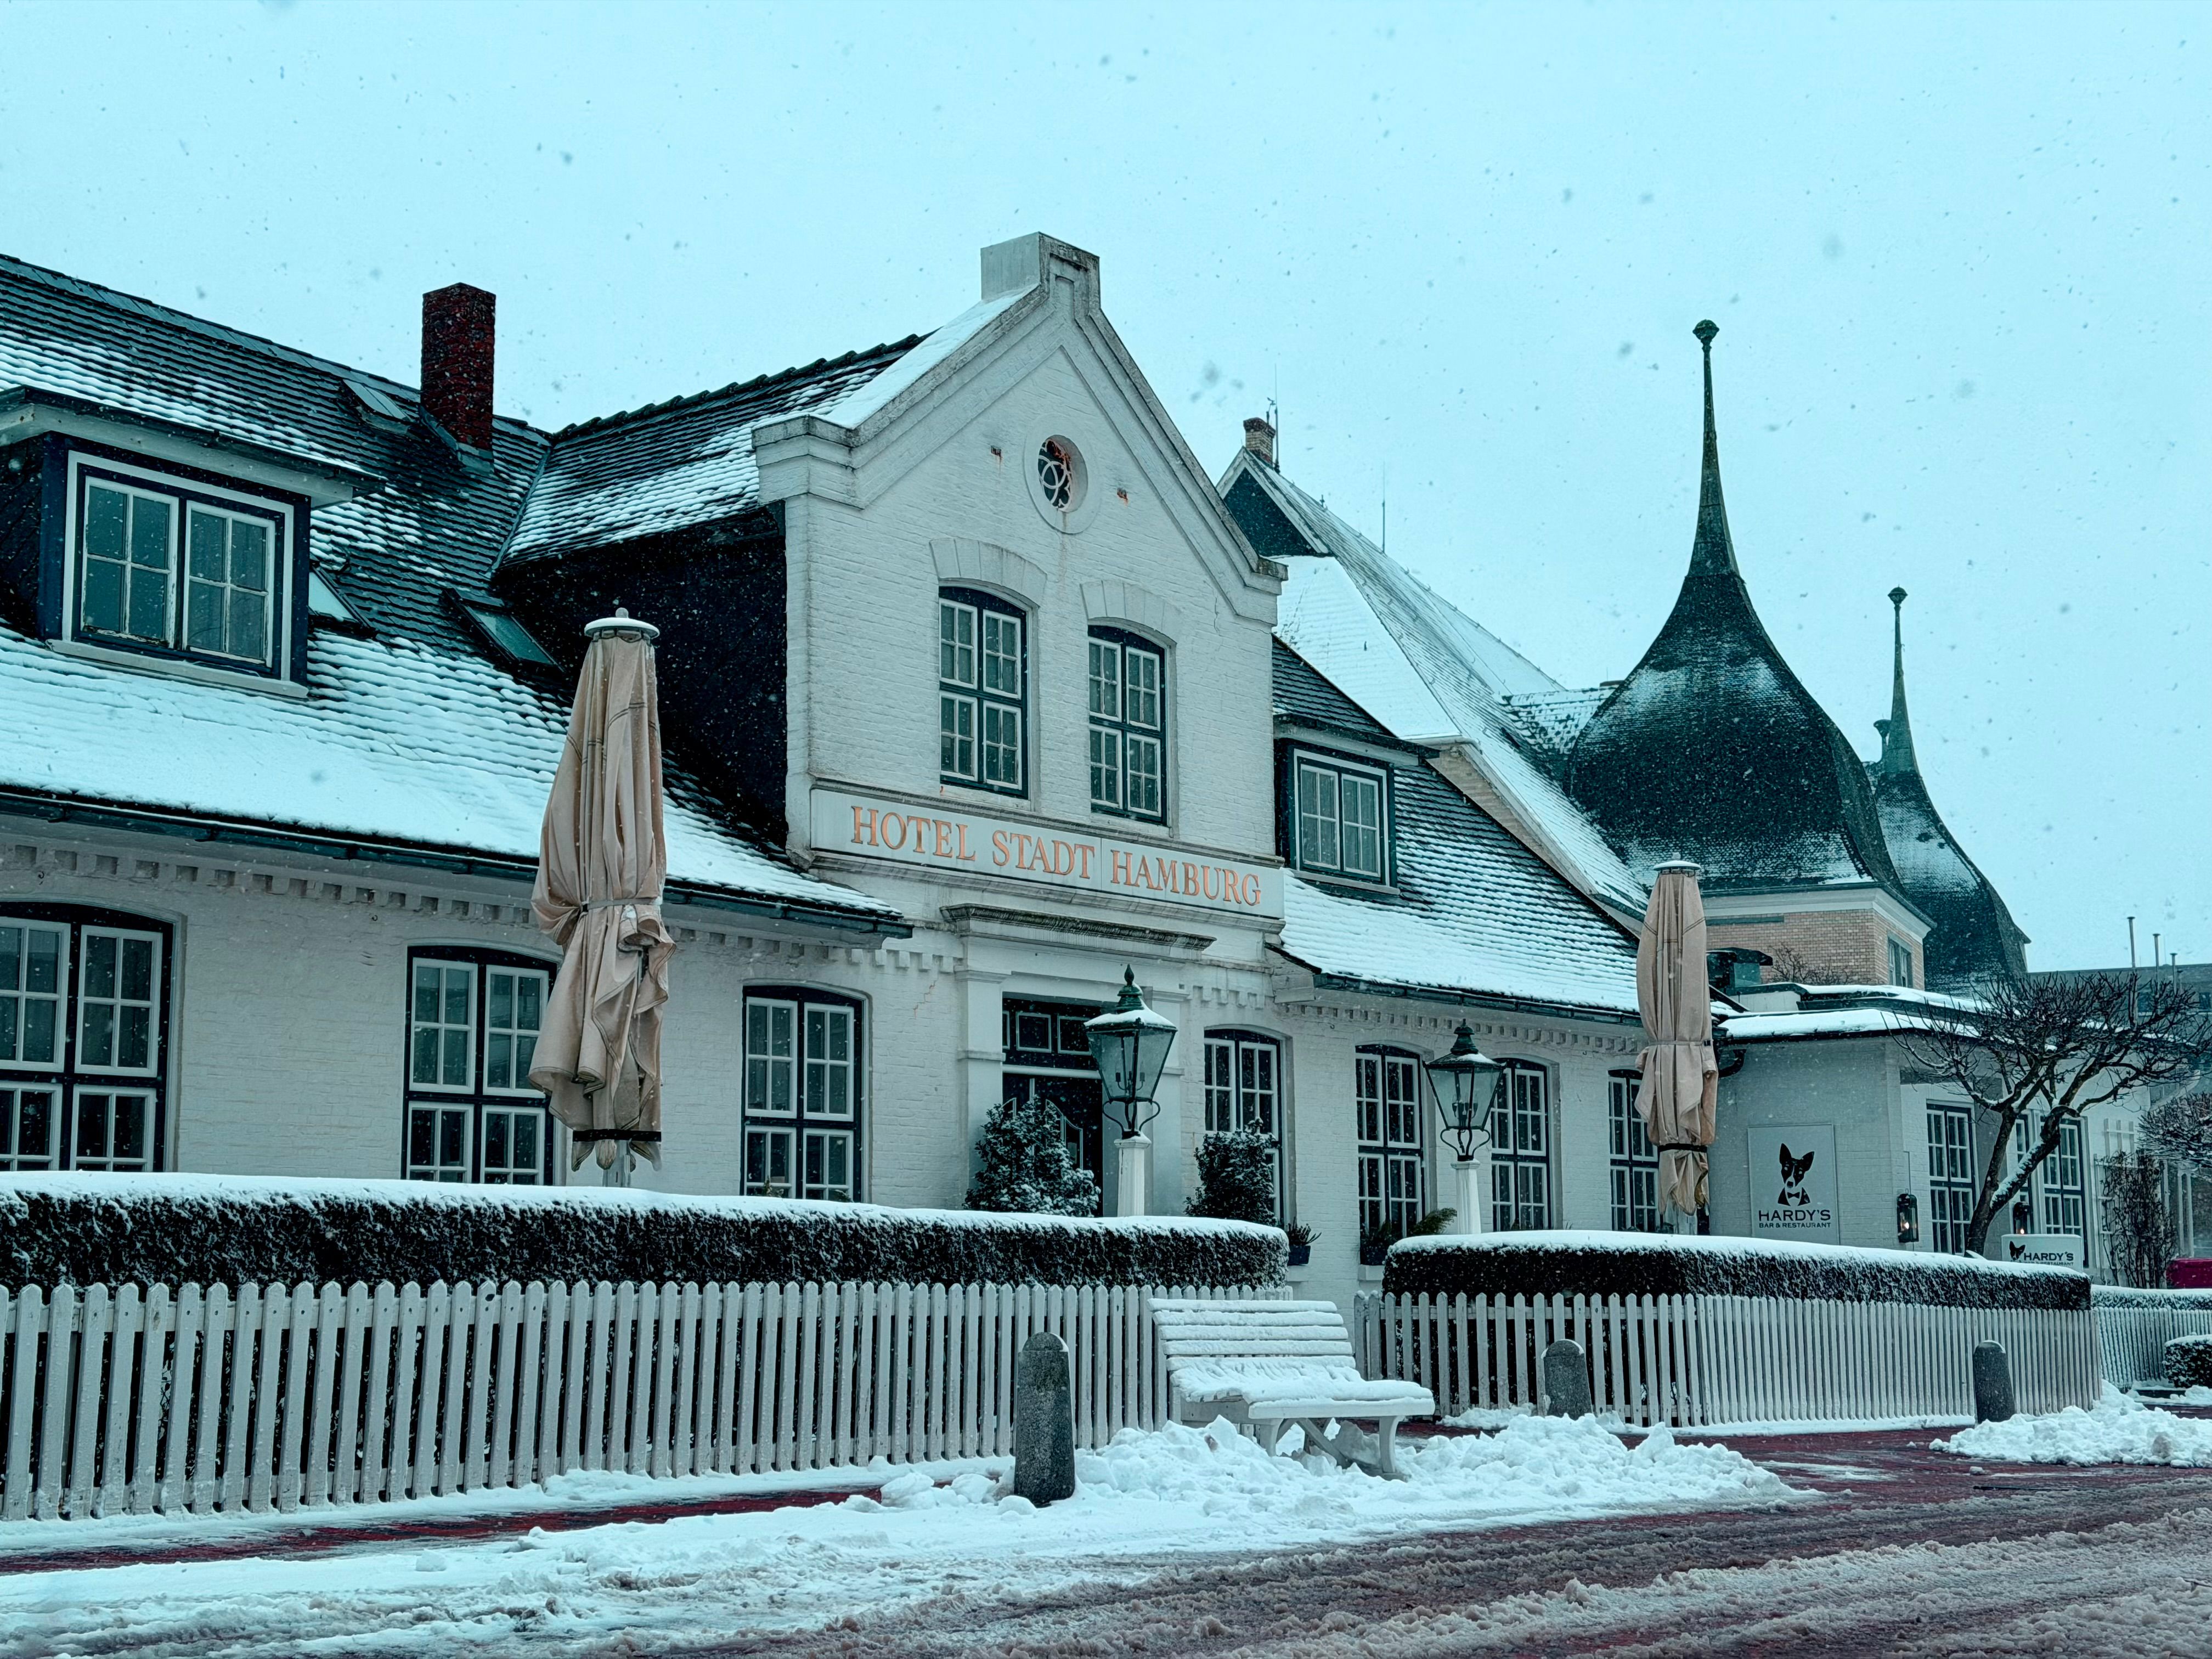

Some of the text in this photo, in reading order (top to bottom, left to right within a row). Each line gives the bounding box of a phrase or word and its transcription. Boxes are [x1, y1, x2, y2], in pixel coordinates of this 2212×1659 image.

[850, 805, 1262, 906] HOTEL STADT HAMBURG
[1758, 1209, 1831, 1222] HARDY'S
[2023, 1251, 2074, 1261] HARDY'S
